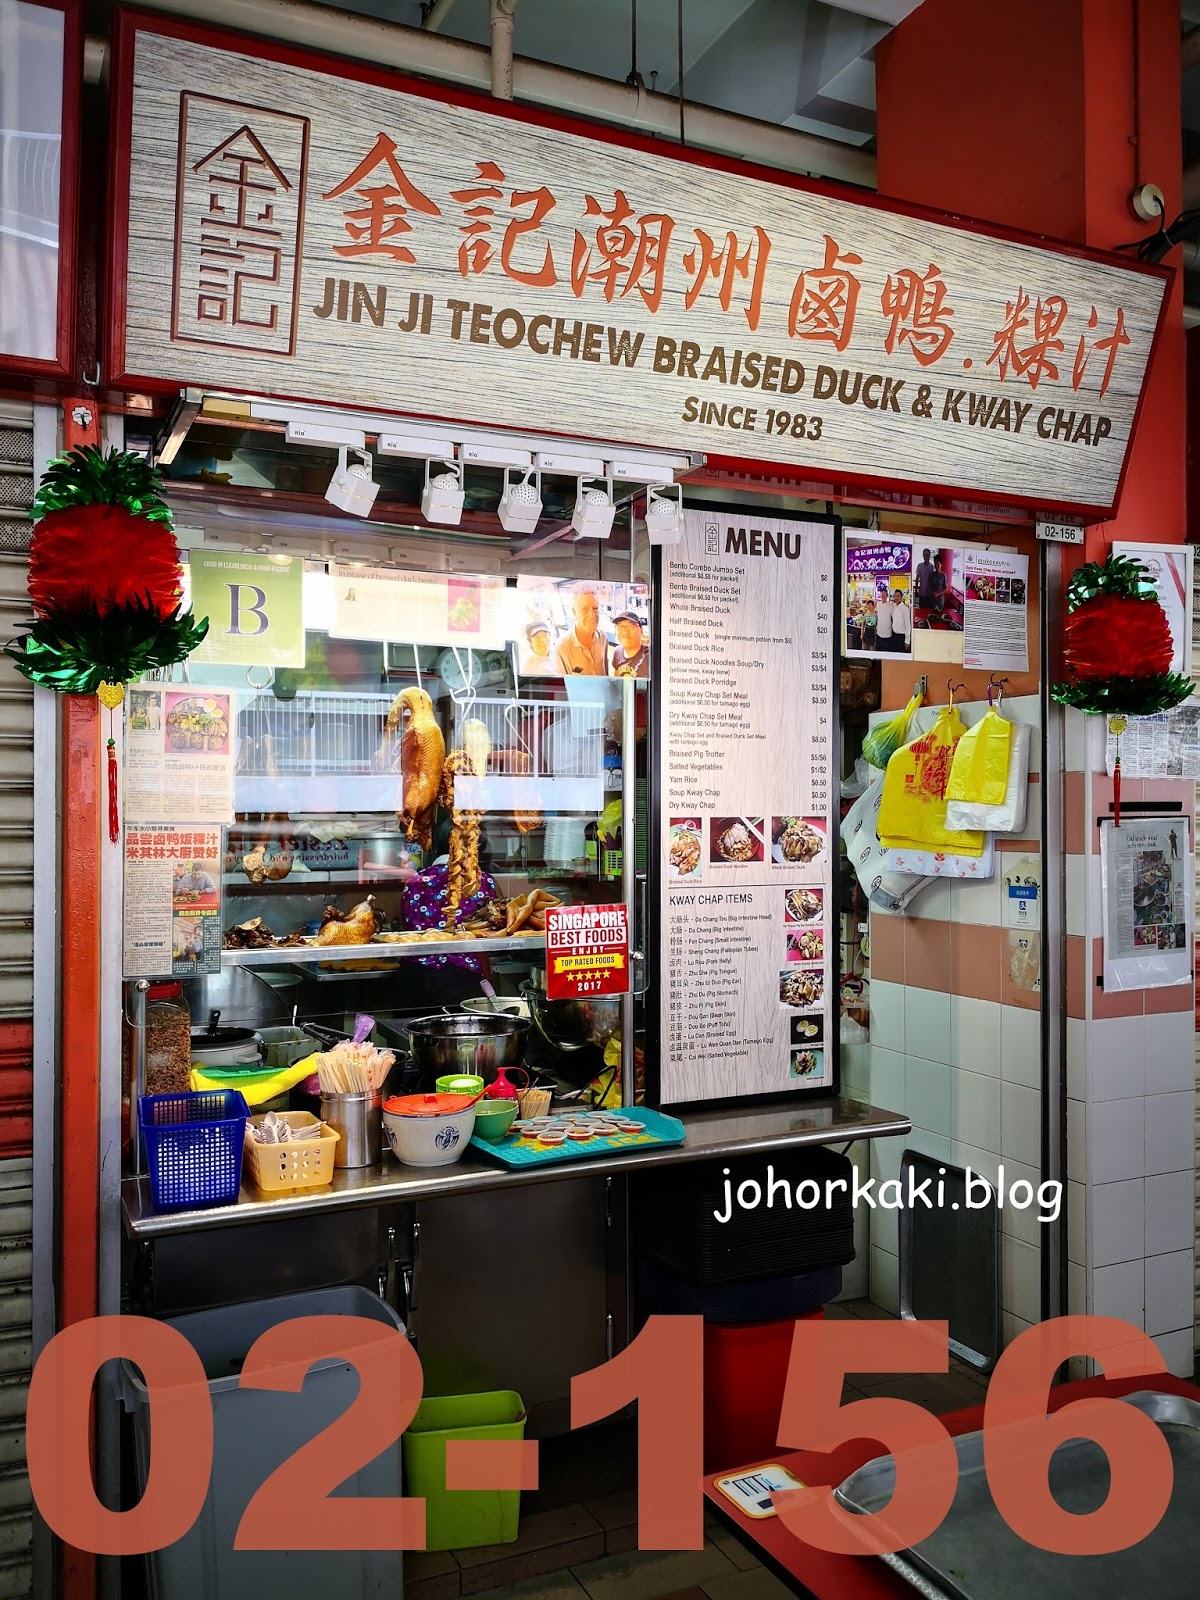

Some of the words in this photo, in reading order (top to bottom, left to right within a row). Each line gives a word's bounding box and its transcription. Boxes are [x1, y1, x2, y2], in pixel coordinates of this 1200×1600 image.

[313, 278, 386, 326] JIN
[399, 293, 434, 334] JI
[446, 299, 644, 368] TEOCHEW
[653, 337, 805, 395] BRAISED
[813, 367, 903, 412] DUCK
[912, 385, 932, 419] &
[942, 389, 1033, 433] KWAY
[1036, 408, 1111, 446] CHAP
[682, 397, 756, 432] SINCE
[765, 409, 823, 440] 1983
[1045, 526, 1075, 540] 02-156
[725, 527, 801, 560] MENU
[224, 562, 252, 570] CLEANLINESS
[690, 563, 711, 571] Combo
[713, 565, 733, 573] Jumbo
[339, 569, 345, 577] In
[347, 572, 367, 580] praise
[376, 573, 400, 581] braised
[401, 575, 417, 583] duck
[690, 584, 712, 592] Braised
[714, 586, 729, 594] Duck
[821, 594, 827, 602] $6
[224, 583, 269, 635] B
[715, 606, 730, 614] Duck
[684, 618, 706, 626] Braised
[670, 630, 692, 638] Braised
[694, 631, 709, 639] Duck
[756, 636, 771, 644] potion
[670, 656, 692, 664] Braised
[737, 660, 764, 669] Soup/Dry
[670, 676, 692, 684] Braised
[694, 677, 709, 685] Duck
[711, 678, 736, 687] Porridge
[705, 691, 720, 699] Chap
[682, 712, 698, 720] Kway
[700, 712, 715, 720] Chap
[694, 750, 703, 759] Pig
[690, 763, 723, 771] Vegetables
[811, 766, 827, 774] $1/$2
[811, 779, 827, 787] $0.50
[669, 789, 685, 797] Soup
[687, 789, 703, 797] Kway
[705, 789, 720, 797] Chap
[669, 801, 679, 810] Dry
[681, 801, 698, 810] Kway
[699, 801, 715, 810] Chap
[126, 833, 218, 845] 品尝卤鸭饭粿汁
[126, 847, 218, 859] 米其林大厨赞好
[669, 895, 695, 905] KWAY
[698, 895, 723, 905] CHAP
[726, 894, 753, 903] ITEMS
[549, 911, 625, 931] SINGAPORE
[551, 931, 581, 946] BEST
[586, 929, 623, 943] FOODS
[572, 946, 604, 955] ENJOY
[561, 959, 573, 967] TOP
[575, 958, 594, 966] RATED
[596, 956, 615, 964] FOODS
[578, 981, 601, 991] 2017
